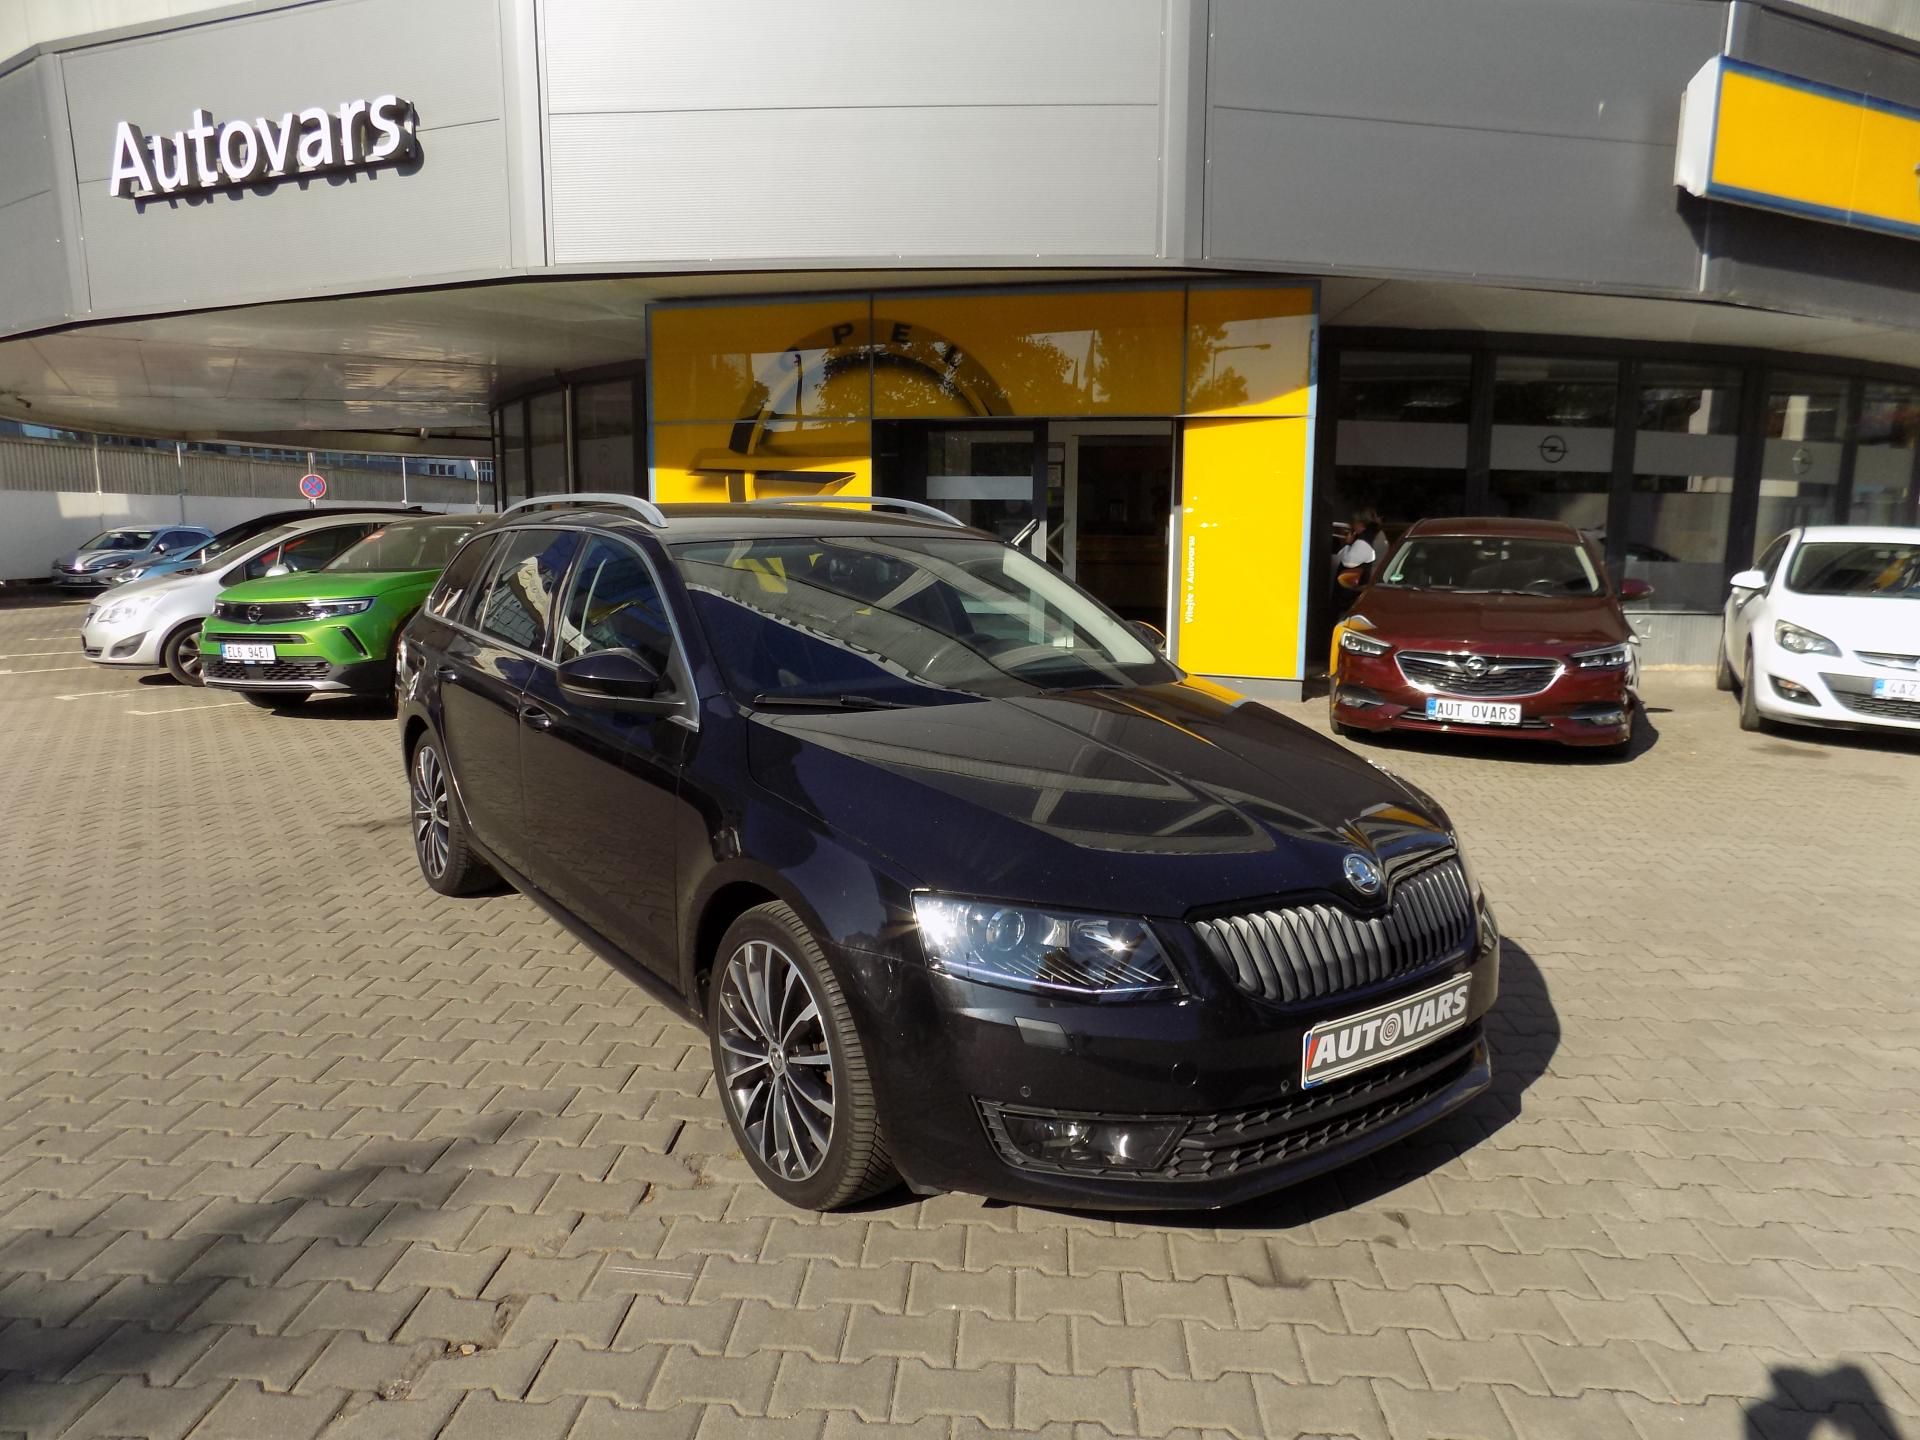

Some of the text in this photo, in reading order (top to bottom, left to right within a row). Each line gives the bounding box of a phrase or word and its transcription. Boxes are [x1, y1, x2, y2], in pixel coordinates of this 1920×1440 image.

[110, 94, 402, 197] Autovars
[227, 646, 243, 658] EL6
[1437, 702, 1517, 721] AUT OVARS
[1311, 985, 1468, 1069] AUTOVARS
